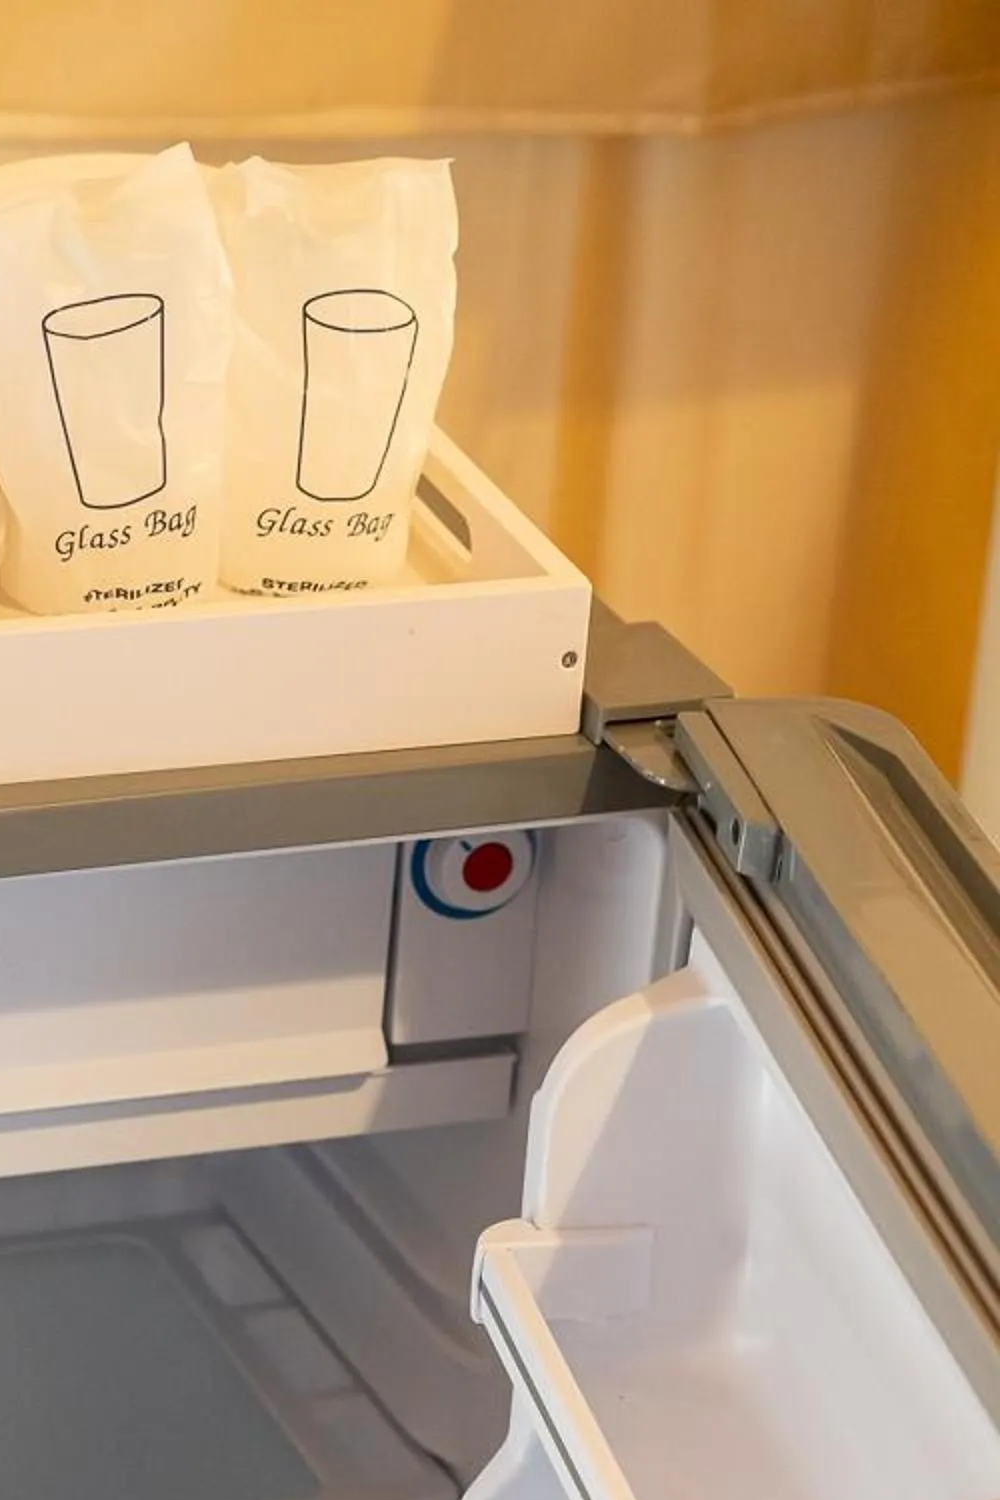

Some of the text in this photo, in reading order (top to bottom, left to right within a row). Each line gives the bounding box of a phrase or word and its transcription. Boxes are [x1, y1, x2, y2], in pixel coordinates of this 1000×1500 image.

[55, 505, 197, 562] Glass Bag
[256, 506, 394, 542] Glass Bag
